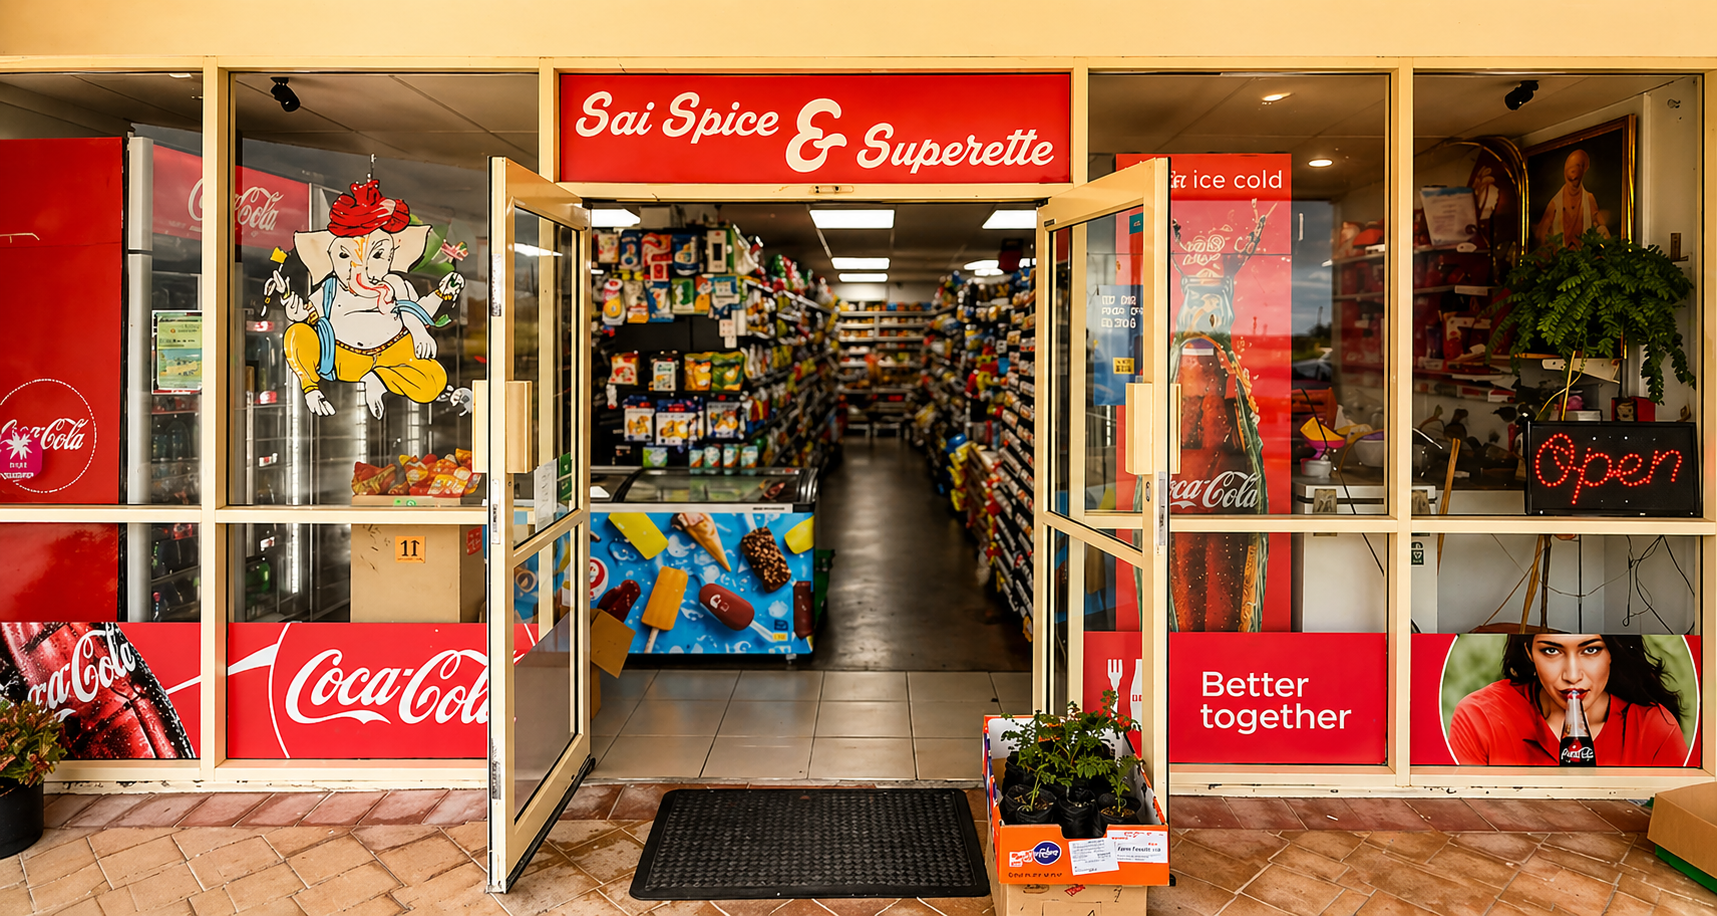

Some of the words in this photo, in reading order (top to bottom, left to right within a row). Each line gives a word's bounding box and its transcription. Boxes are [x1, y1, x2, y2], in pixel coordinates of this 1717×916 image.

[575, 90, 655, 138] Sai
[662, 91, 780, 144] Spice
[785, 98, 848, 173] &
[856, 122, 1056, 174] Superette
[1193, 169, 1226, 189] ice
[1233, 169, 1282, 189] cold
[1534, 432, 1683, 505] Open
[1201, 671, 1310, 698] Better
[1199, 702, 1353, 735] together
